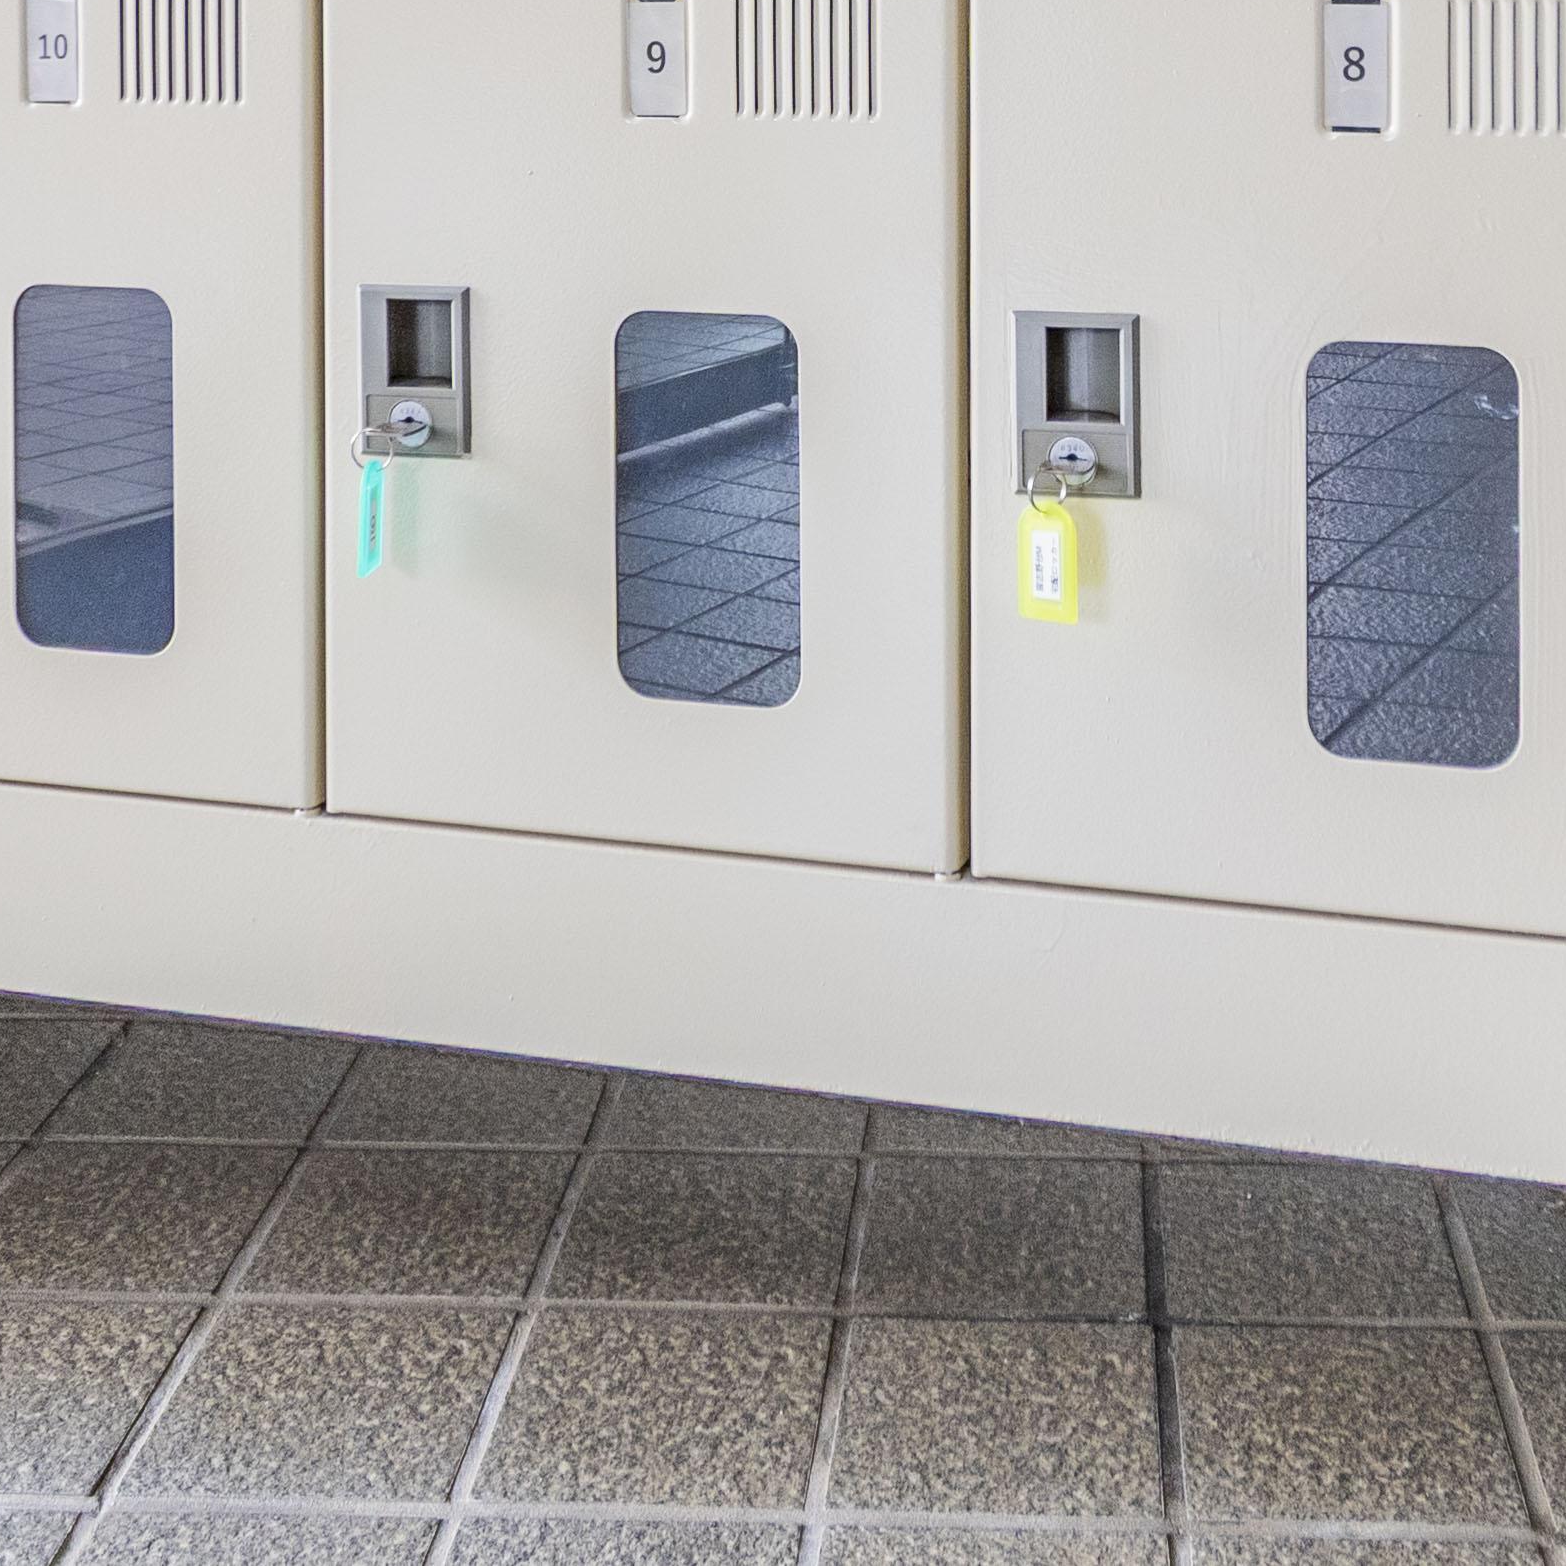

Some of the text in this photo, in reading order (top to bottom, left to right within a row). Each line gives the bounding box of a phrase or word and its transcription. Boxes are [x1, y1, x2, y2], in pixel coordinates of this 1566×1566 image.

[37, 33, 68, 61] 10
[646, 40, 666, 74] 9
[1342, 46, 1366, 82] 8
